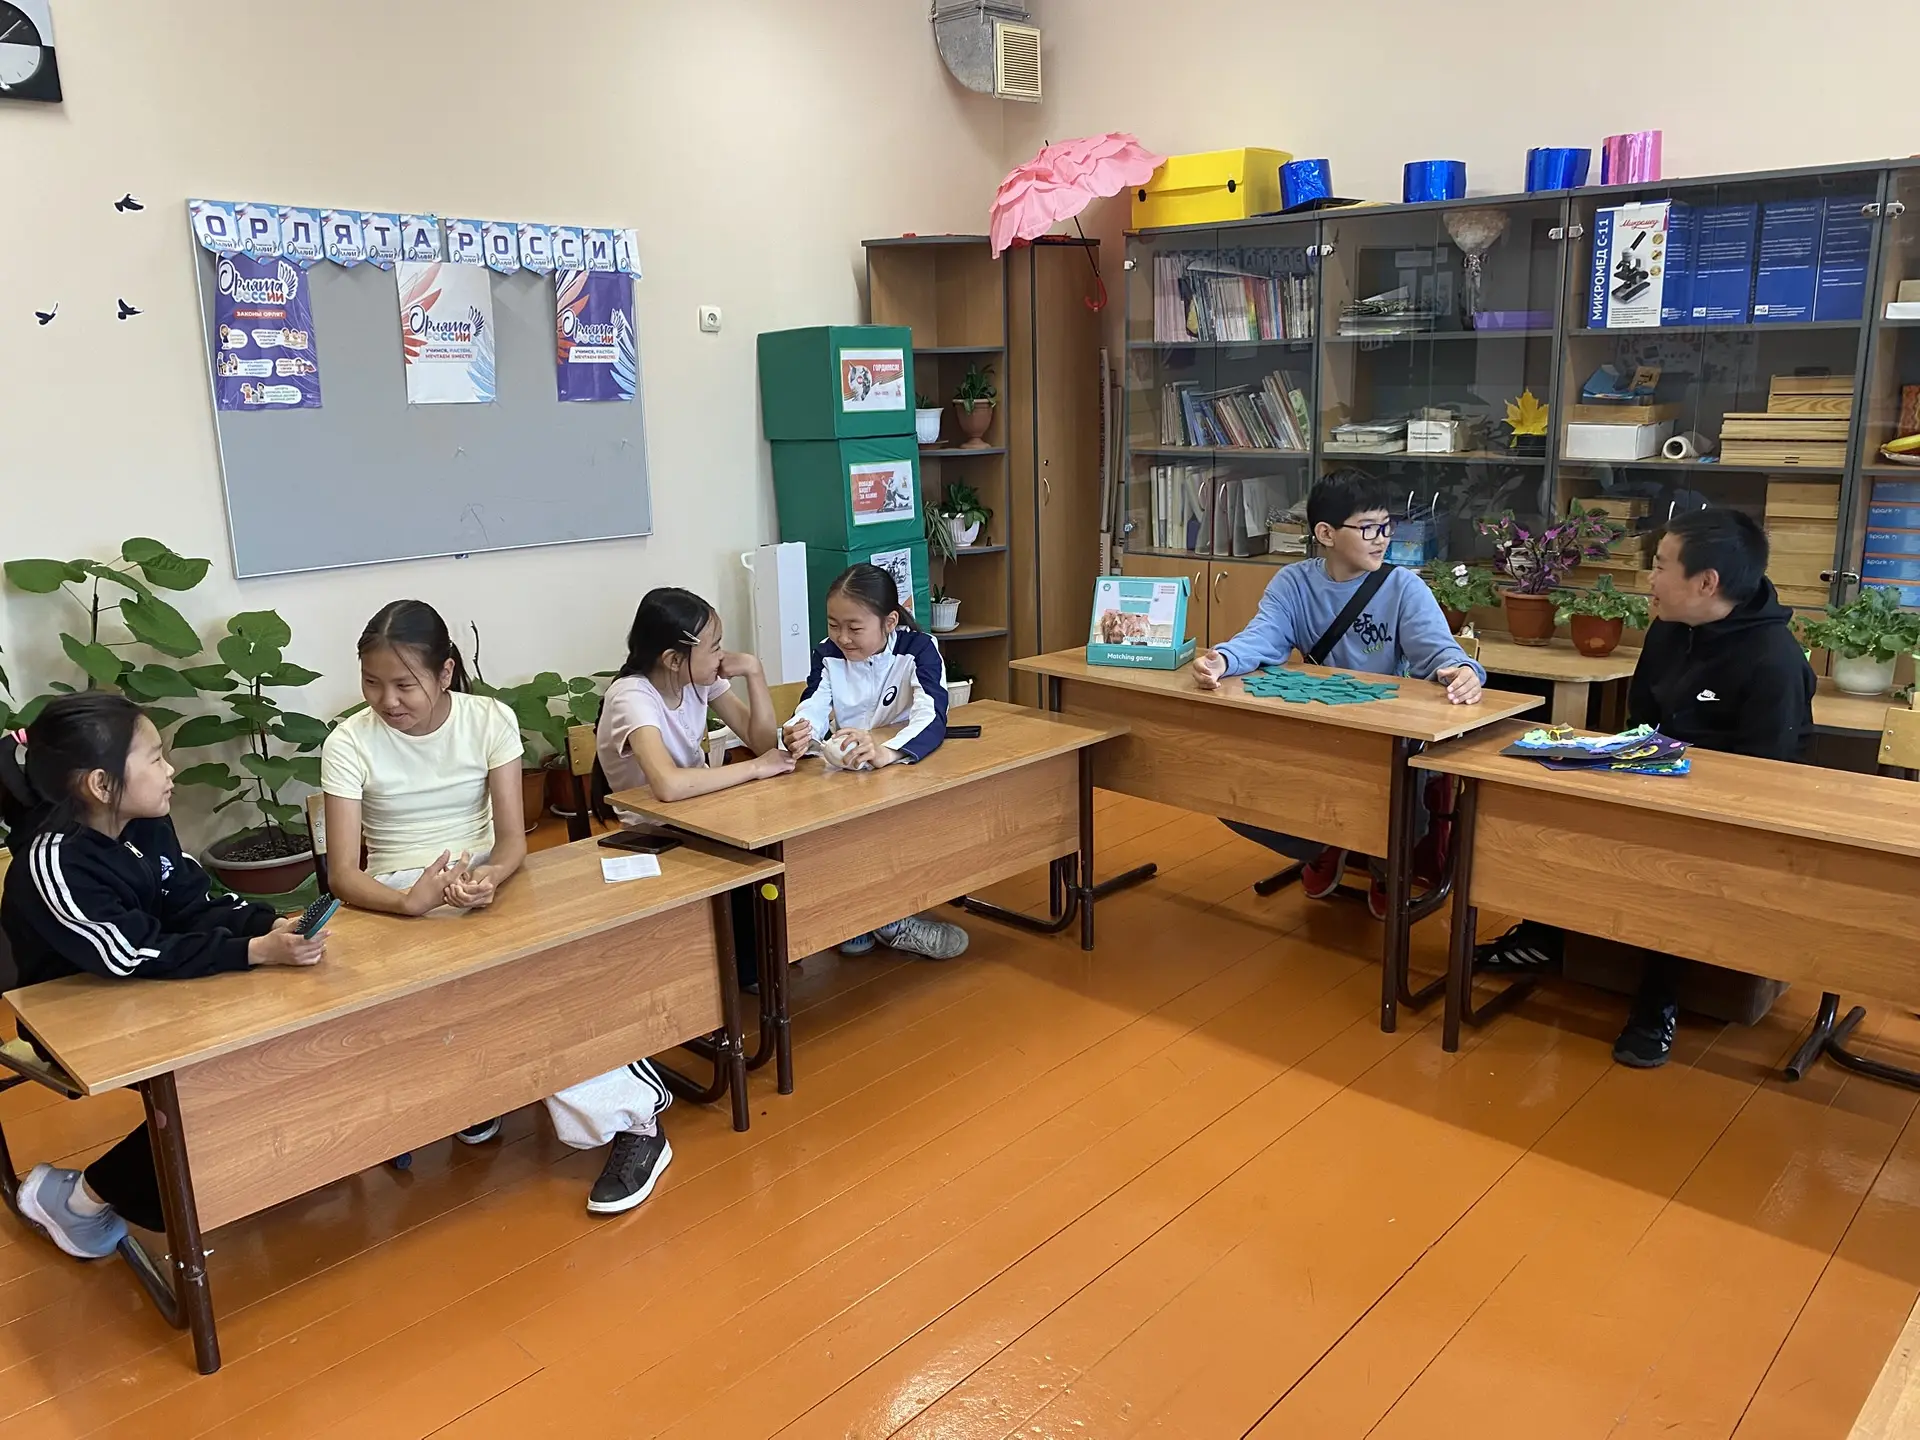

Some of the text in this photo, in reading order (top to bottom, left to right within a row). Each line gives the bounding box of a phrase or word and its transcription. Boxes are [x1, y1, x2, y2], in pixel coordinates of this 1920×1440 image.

[206, 215, 431, 249] ОРЛЯТА
[219, 261, 284, 296] Орлята
[1591, 218, 1609, 320] МИКРОМЕД С-11
[410, 304, 471, 336] Орлята
[563, 309, 614, 338] Орлята
[427, 332, 471, 342] РОССИИ
[1107, 653, 1134, 662] Matching
